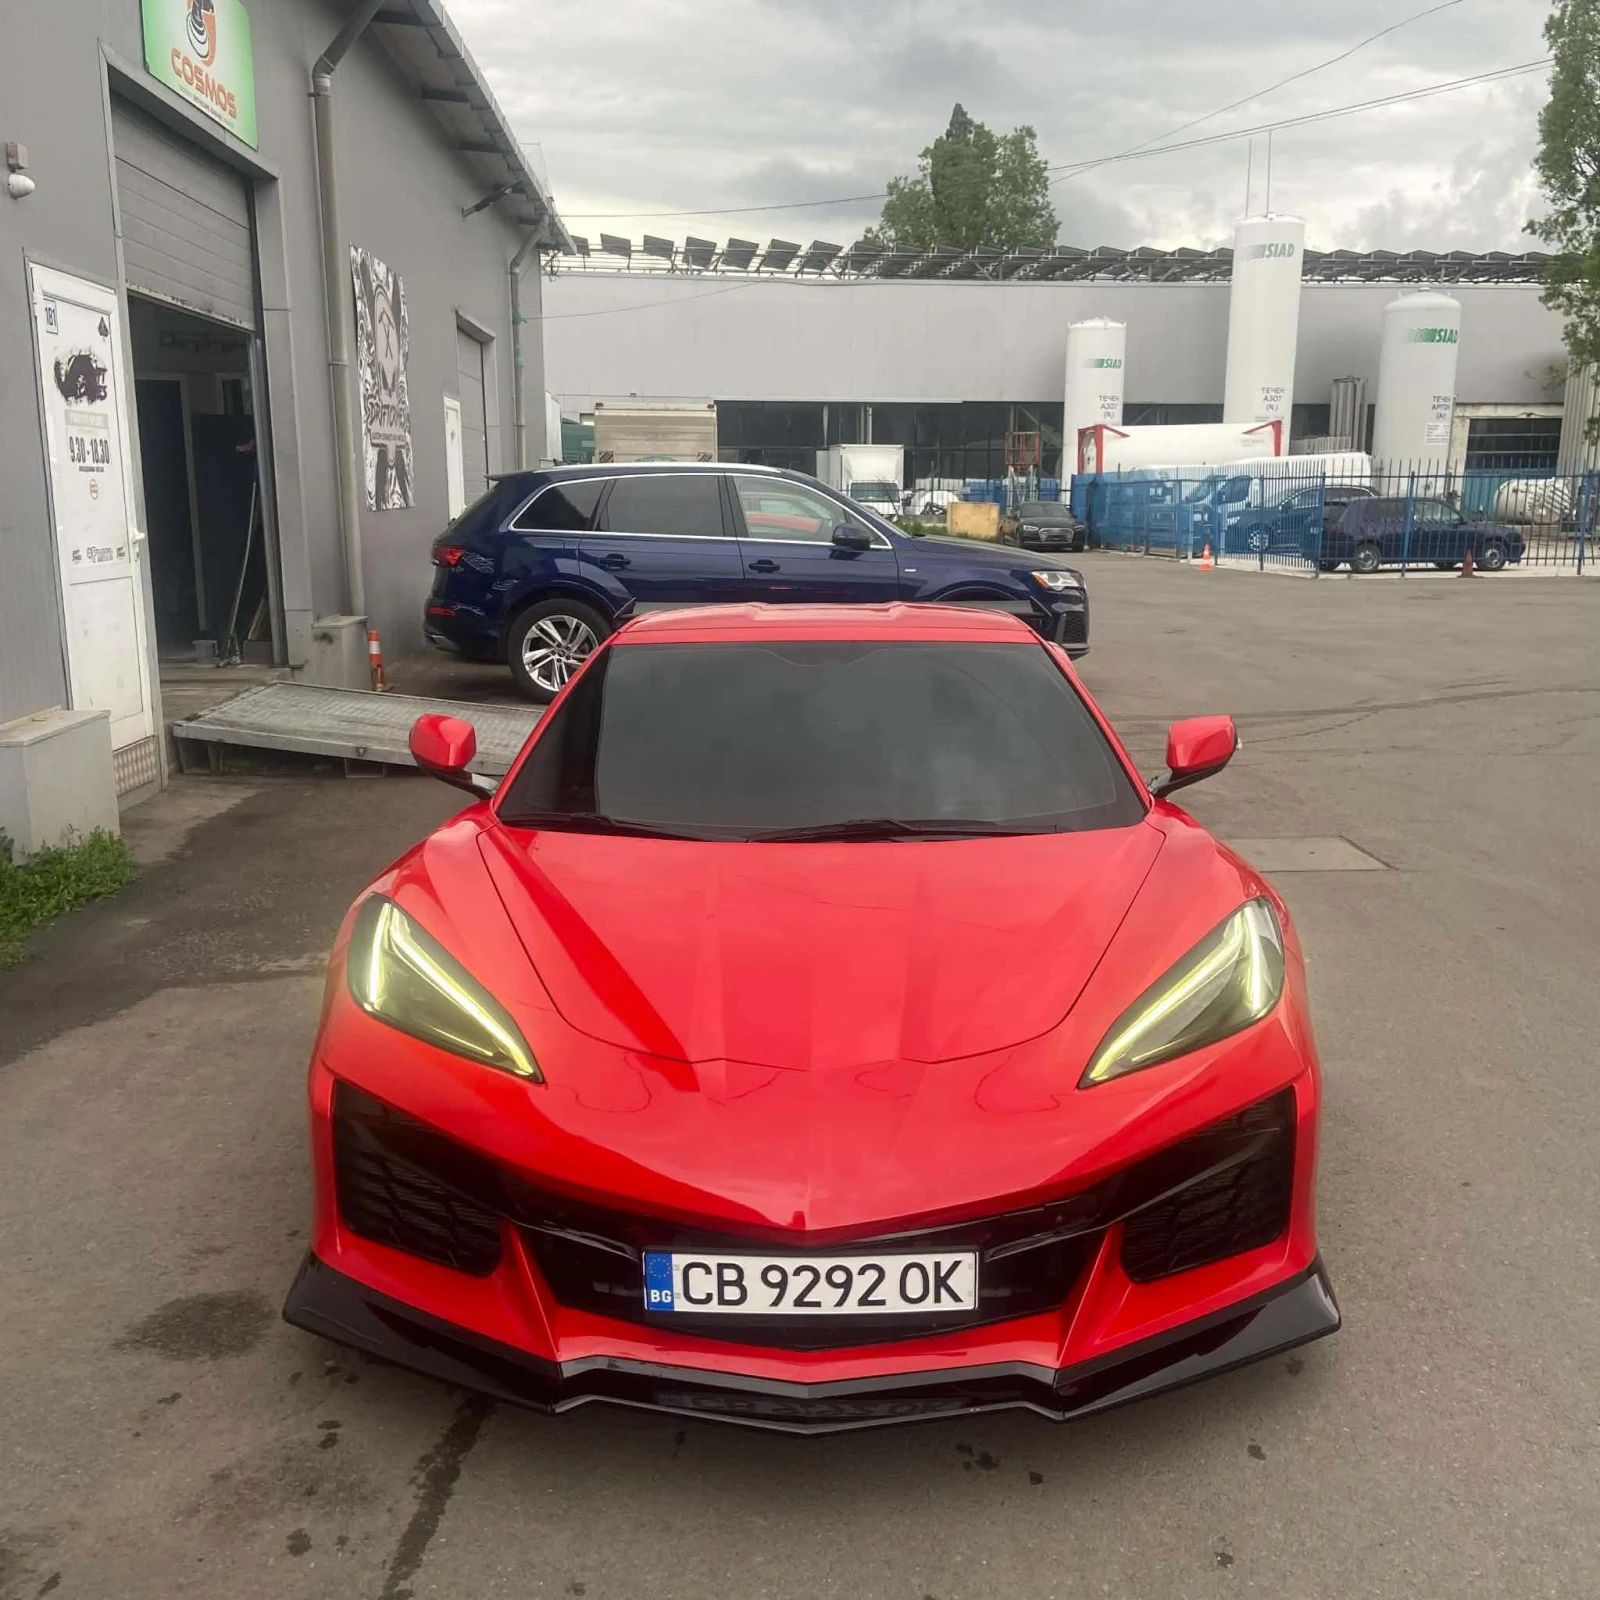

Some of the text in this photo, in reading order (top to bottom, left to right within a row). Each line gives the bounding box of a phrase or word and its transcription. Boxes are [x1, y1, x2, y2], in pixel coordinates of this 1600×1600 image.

[171, 47, 237, 119] COSMOS
[1265, 243, 1295, 258] SIAD
[45, 306, 57, 326] 181
[1436, 328, 1458, 343] SIAD
[1104, 358, 1123, 369] SIAD
[682, 1260, 965, 1308] CB 9292 OK
[650, 1289, 672, 1303] BG
